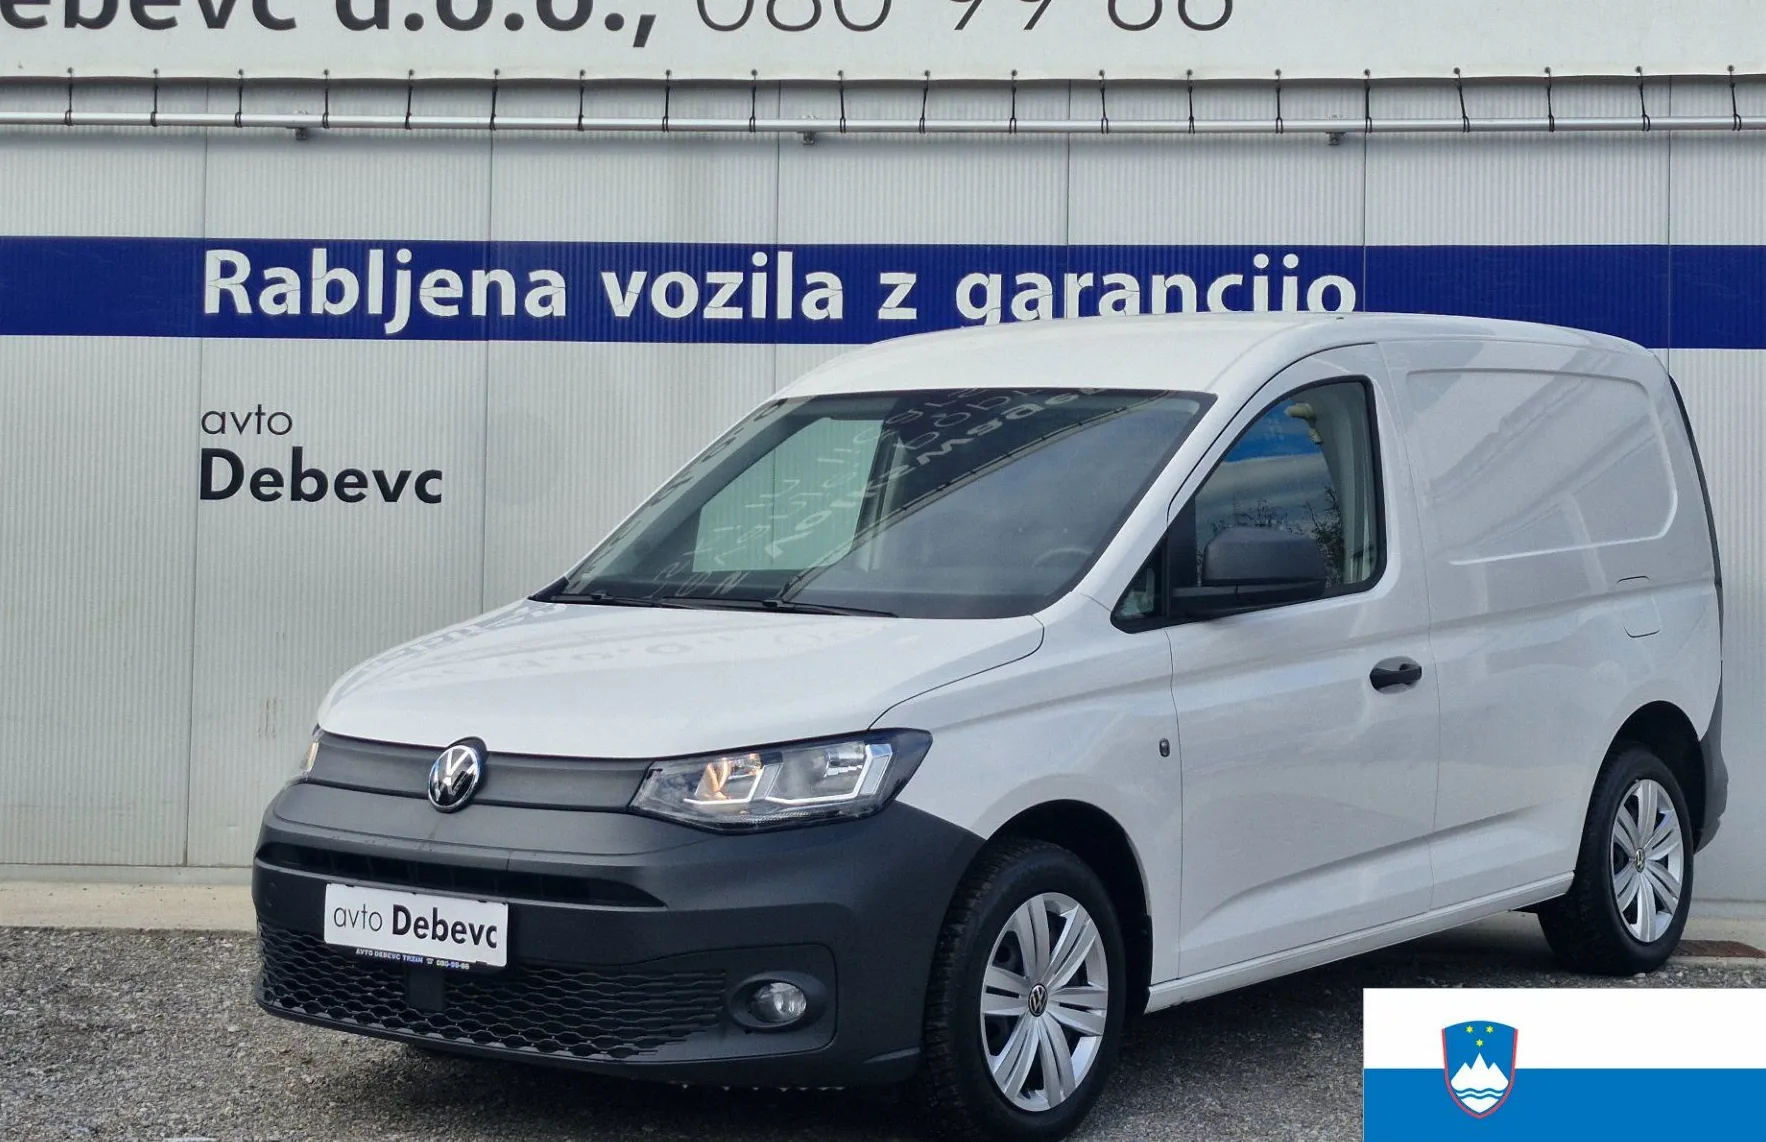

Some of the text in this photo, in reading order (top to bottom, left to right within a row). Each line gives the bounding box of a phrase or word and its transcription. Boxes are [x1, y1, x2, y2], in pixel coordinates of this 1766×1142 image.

[204, 248, 566, 335] Rabljena
[600, 251, 844, 320] vozila
[877, 273, 917, 320] z
[200, 404, 293, 436] avto
[200, 446, 443, 504] Debevc
[333, 903, 498, 949] avto Debevc
[355, 948, 373, 957] AVTO
[374, 950, 401, 961] DEBEVC
